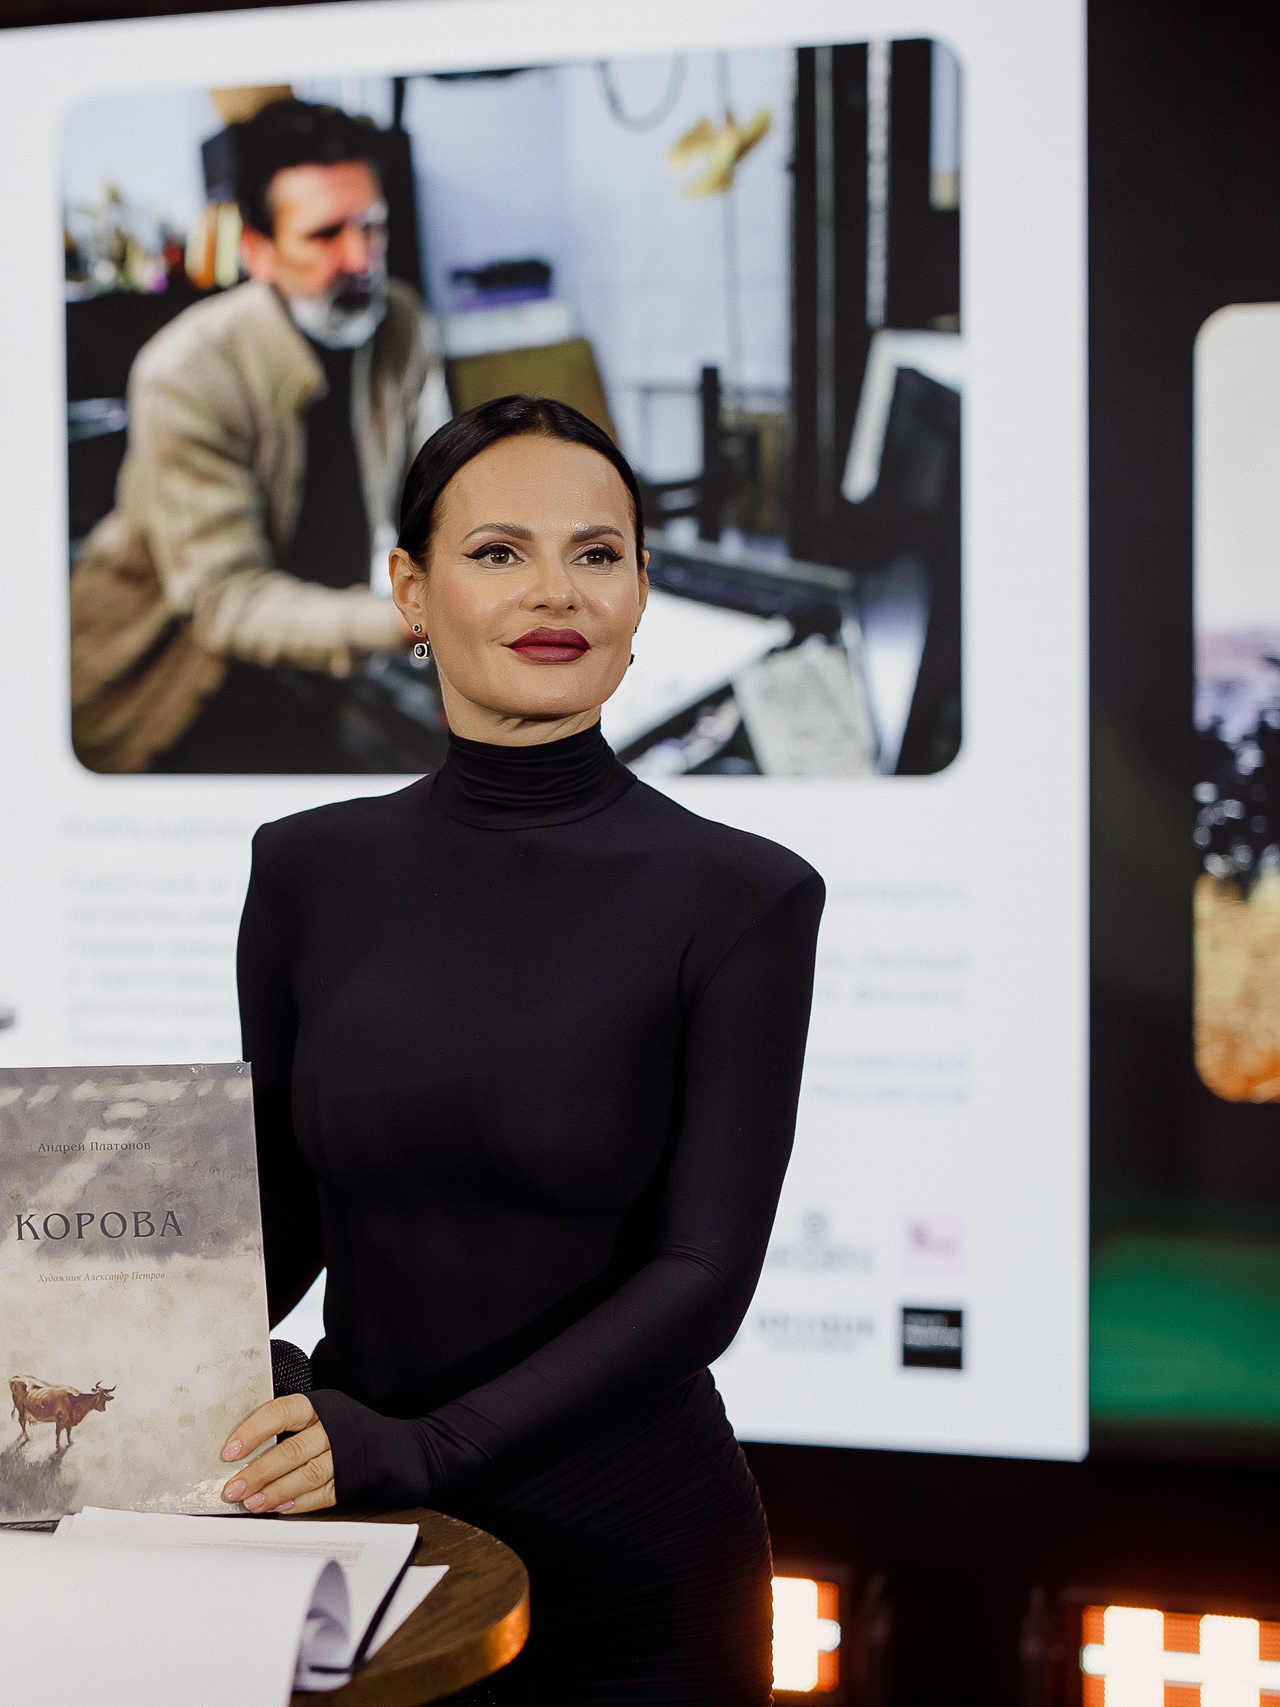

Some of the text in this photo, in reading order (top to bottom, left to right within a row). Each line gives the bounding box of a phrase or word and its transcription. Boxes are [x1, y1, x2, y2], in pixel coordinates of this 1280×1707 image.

[38, 1141, 151, 1154] Андрей Платонов
[15, 1210, 184, 1241] КОРОВА
[37, 1270, 166, 1285] Художник Александр Петров
